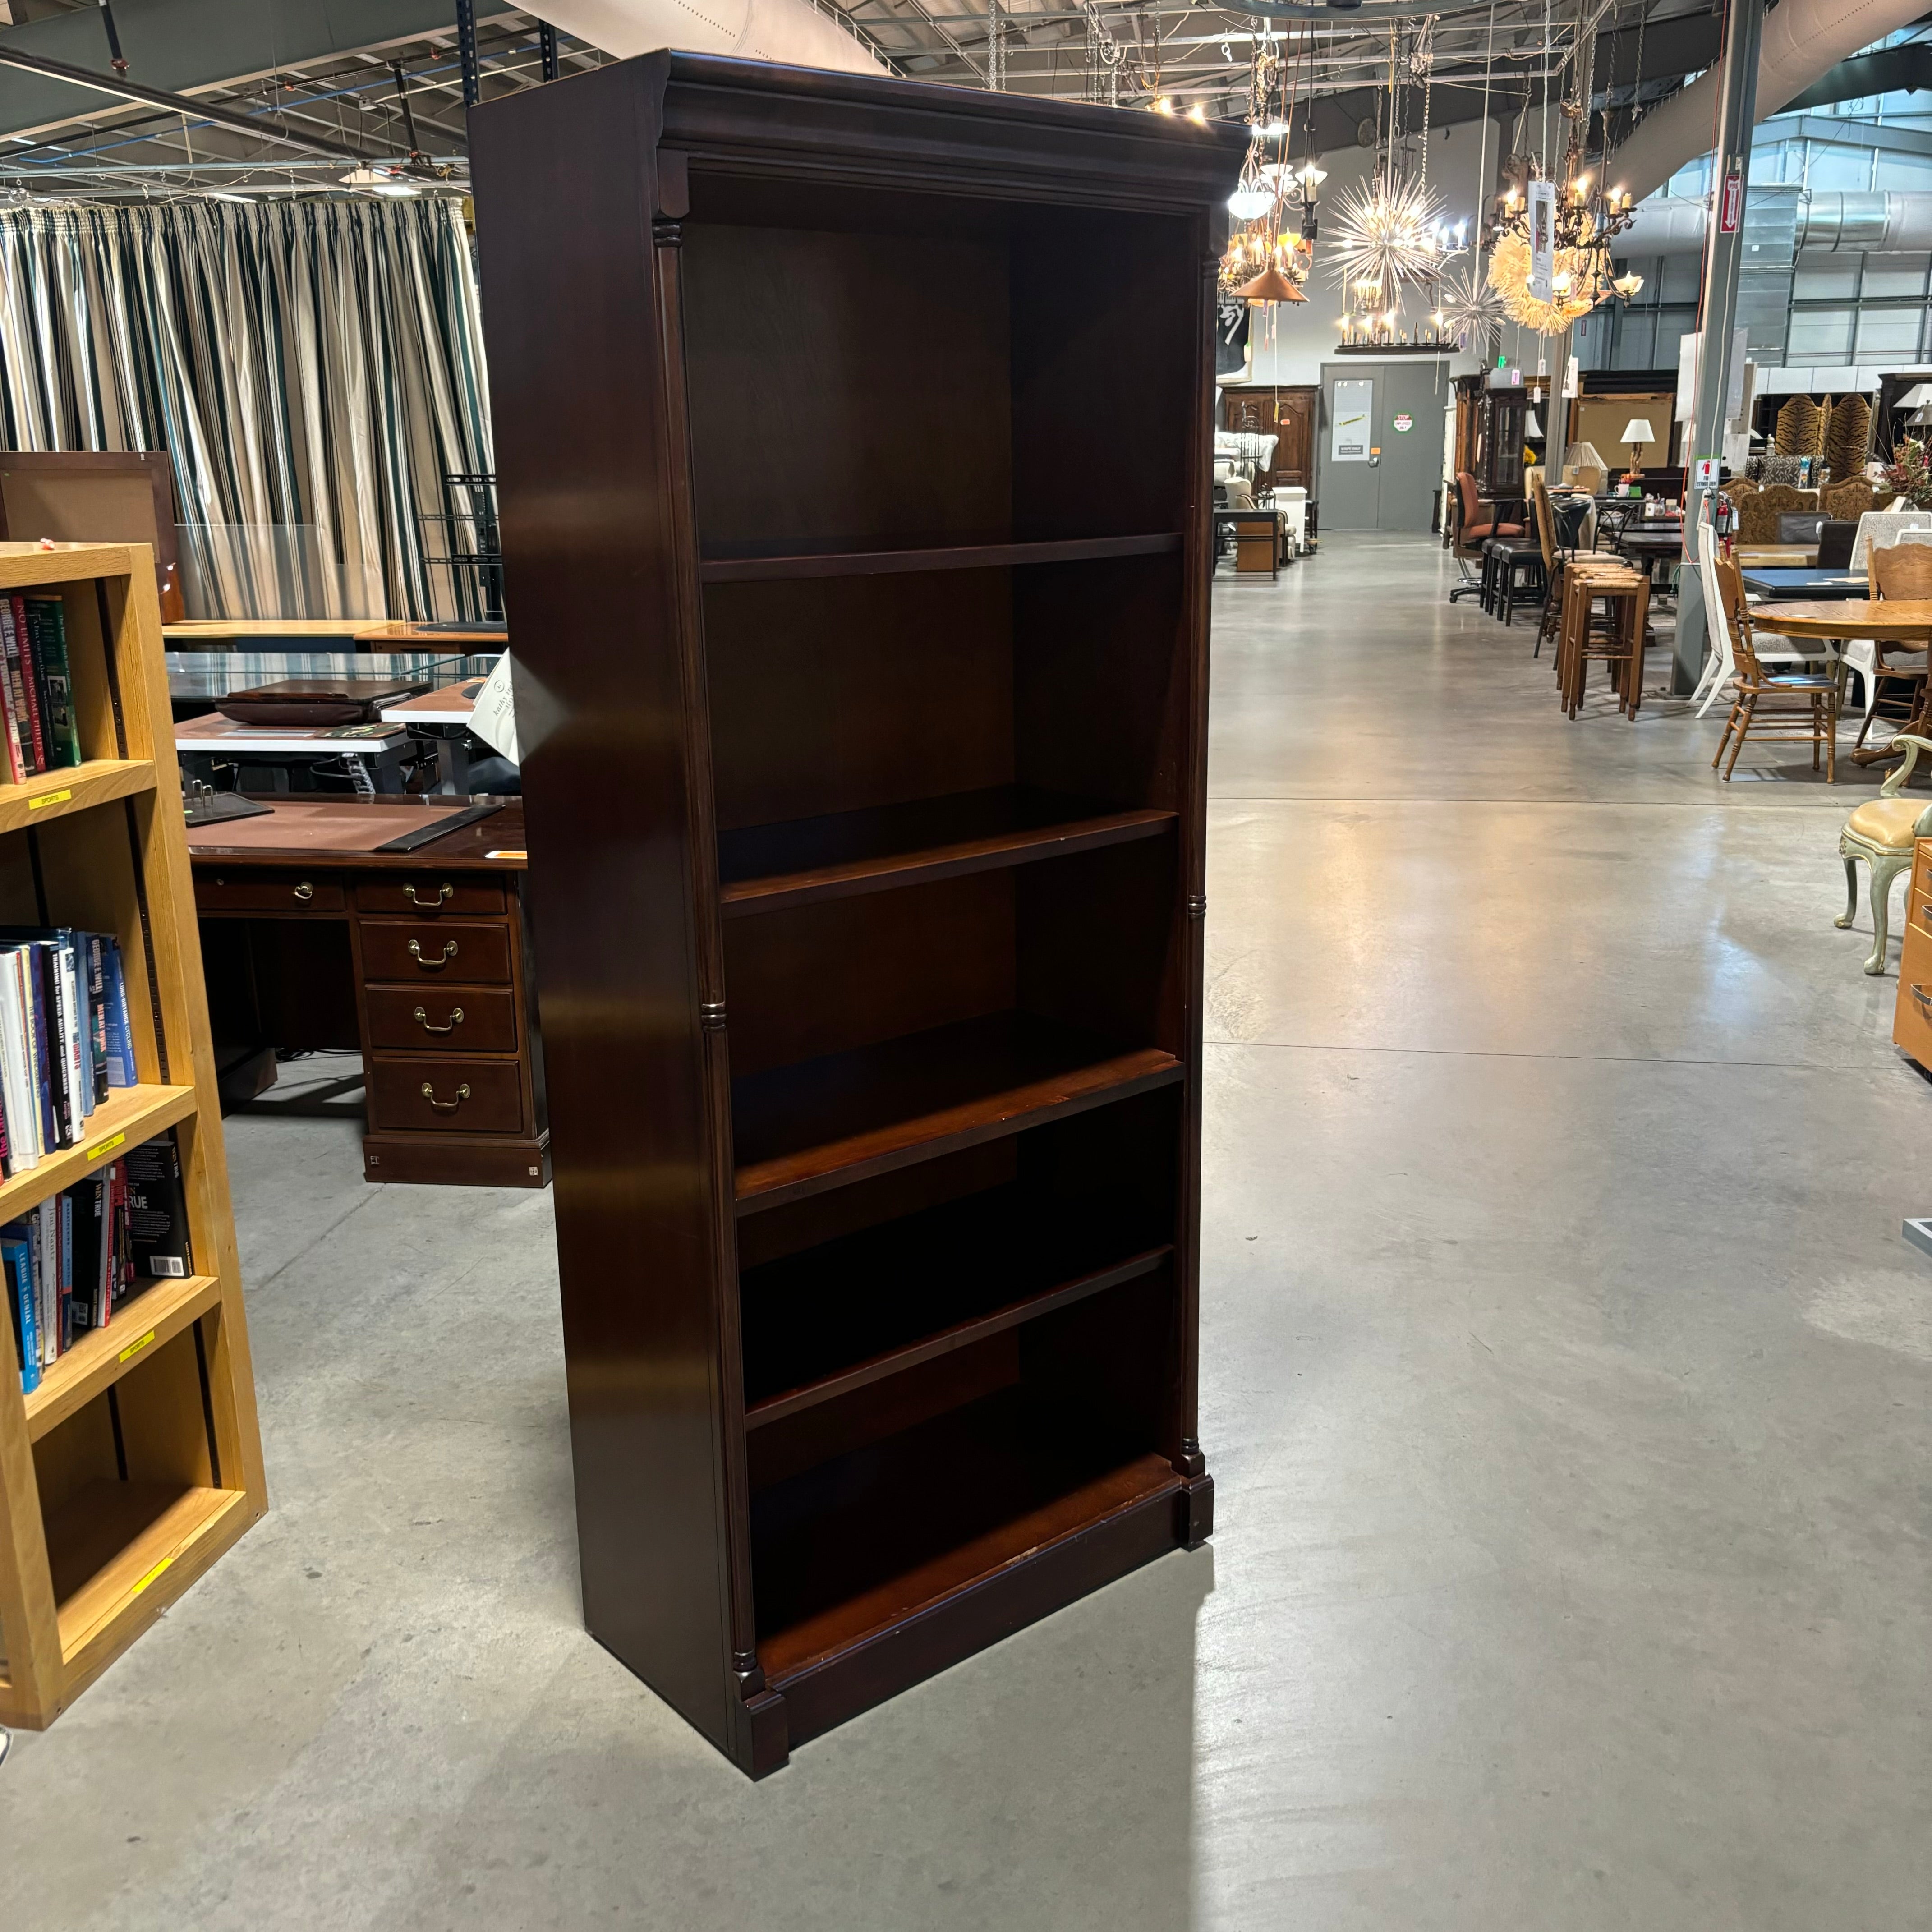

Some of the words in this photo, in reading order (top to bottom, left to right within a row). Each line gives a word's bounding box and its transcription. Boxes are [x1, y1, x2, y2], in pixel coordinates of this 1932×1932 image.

[17, 605, 26, 623] NO
[21, 627, 31, 665] LIMITS
[28, 677, 38, 715] MICHAEL
[493, 696, 507, 716] kathy
[34, 720, 43, 751] PHELPS
[52, 952, 60, 985] TRAINING
[60, 1058, 69, 1095] QUICKNESS
[129, 1196, 148, 1209] RUE
[23, 1293, 31, 1324] DENIAL
